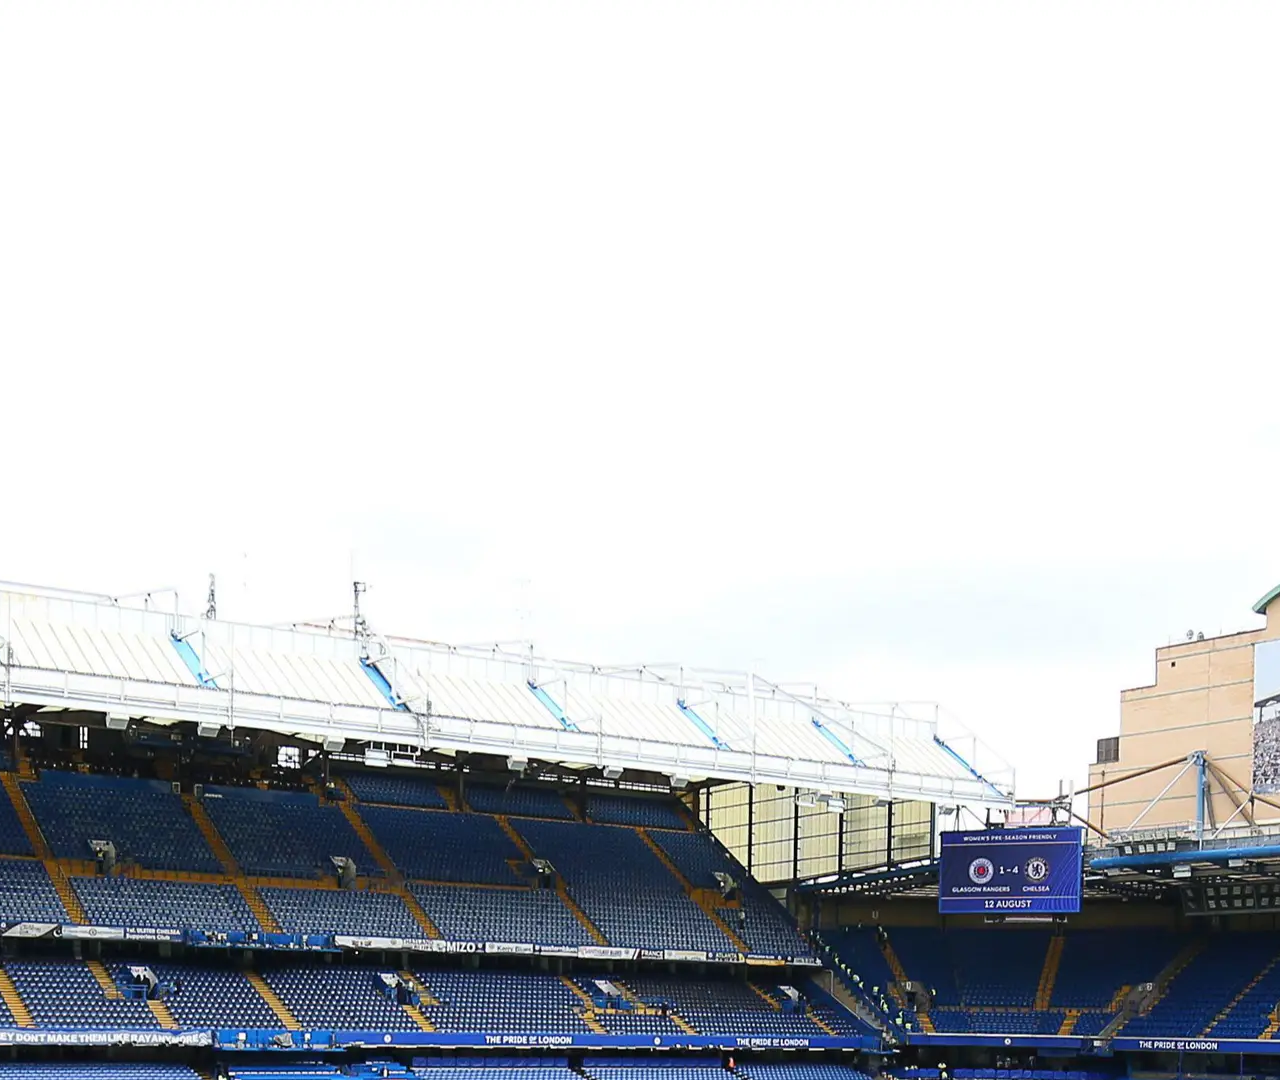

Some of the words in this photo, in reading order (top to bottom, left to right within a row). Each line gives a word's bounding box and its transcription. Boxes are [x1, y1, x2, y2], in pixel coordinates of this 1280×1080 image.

[984, 900, 994, 908] 12
[996, 900, 1031, 909] AUGUST
[446, 942, 476, 952] MIZO
[15, 1032, 46, 1043] DONT
[47, 1032, 77, 1043] MAKE
[79, 1032, 106, 1043] THEM
[108, 1033, 130, 1043] LIKE
[485, 1036, 501, 1044] THE
[503, 1036, 527, 1044] PRIDE
[528, 1036, 537, 1044] OF
[538, 1036, 572, 1044] LONDON
[736, 1038, 749, 1046] THE
[751, 1038, 771, 1046] PRIDE
[780, 1038, 808, 1046] LONDON
[1154, 1041, 1175, 1049] PRIDE
[1185, 1041, 1217, 1050] LONDON
